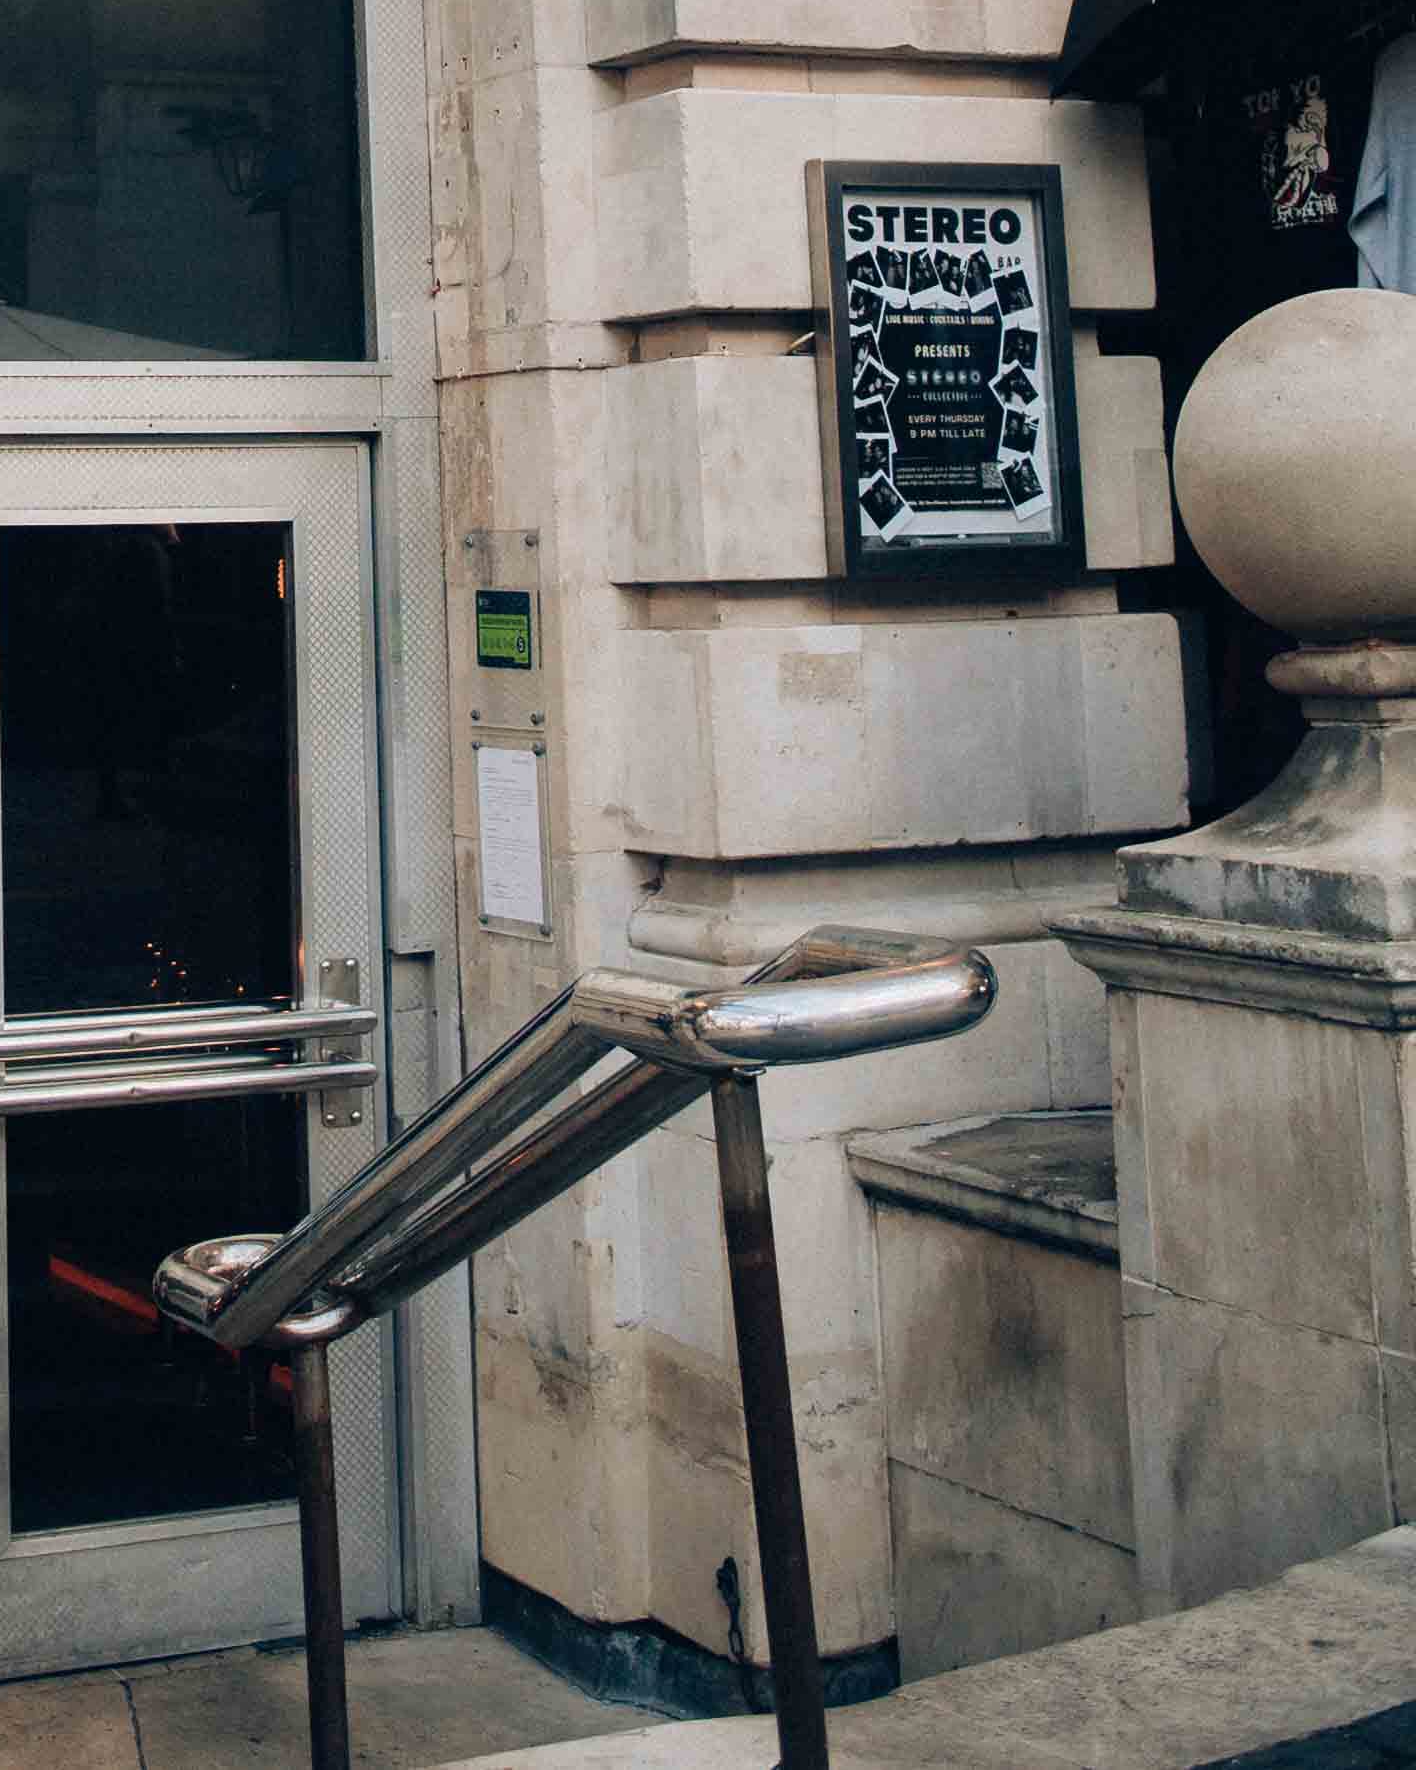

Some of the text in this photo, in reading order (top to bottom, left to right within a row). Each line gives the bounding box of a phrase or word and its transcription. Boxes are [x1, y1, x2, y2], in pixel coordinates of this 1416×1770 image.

[847, 204, 1021, 245] STEREO
[914, 344, 971, 358] PRESENTS
[905, 369, 982, 384] STEREO
[907, 414, 985, 423] EVERY THURSDAY
[920, 429, 937, 438] PM
[939, 429, 959, 438] TILL
[962, 428, 986, 438] LATE
